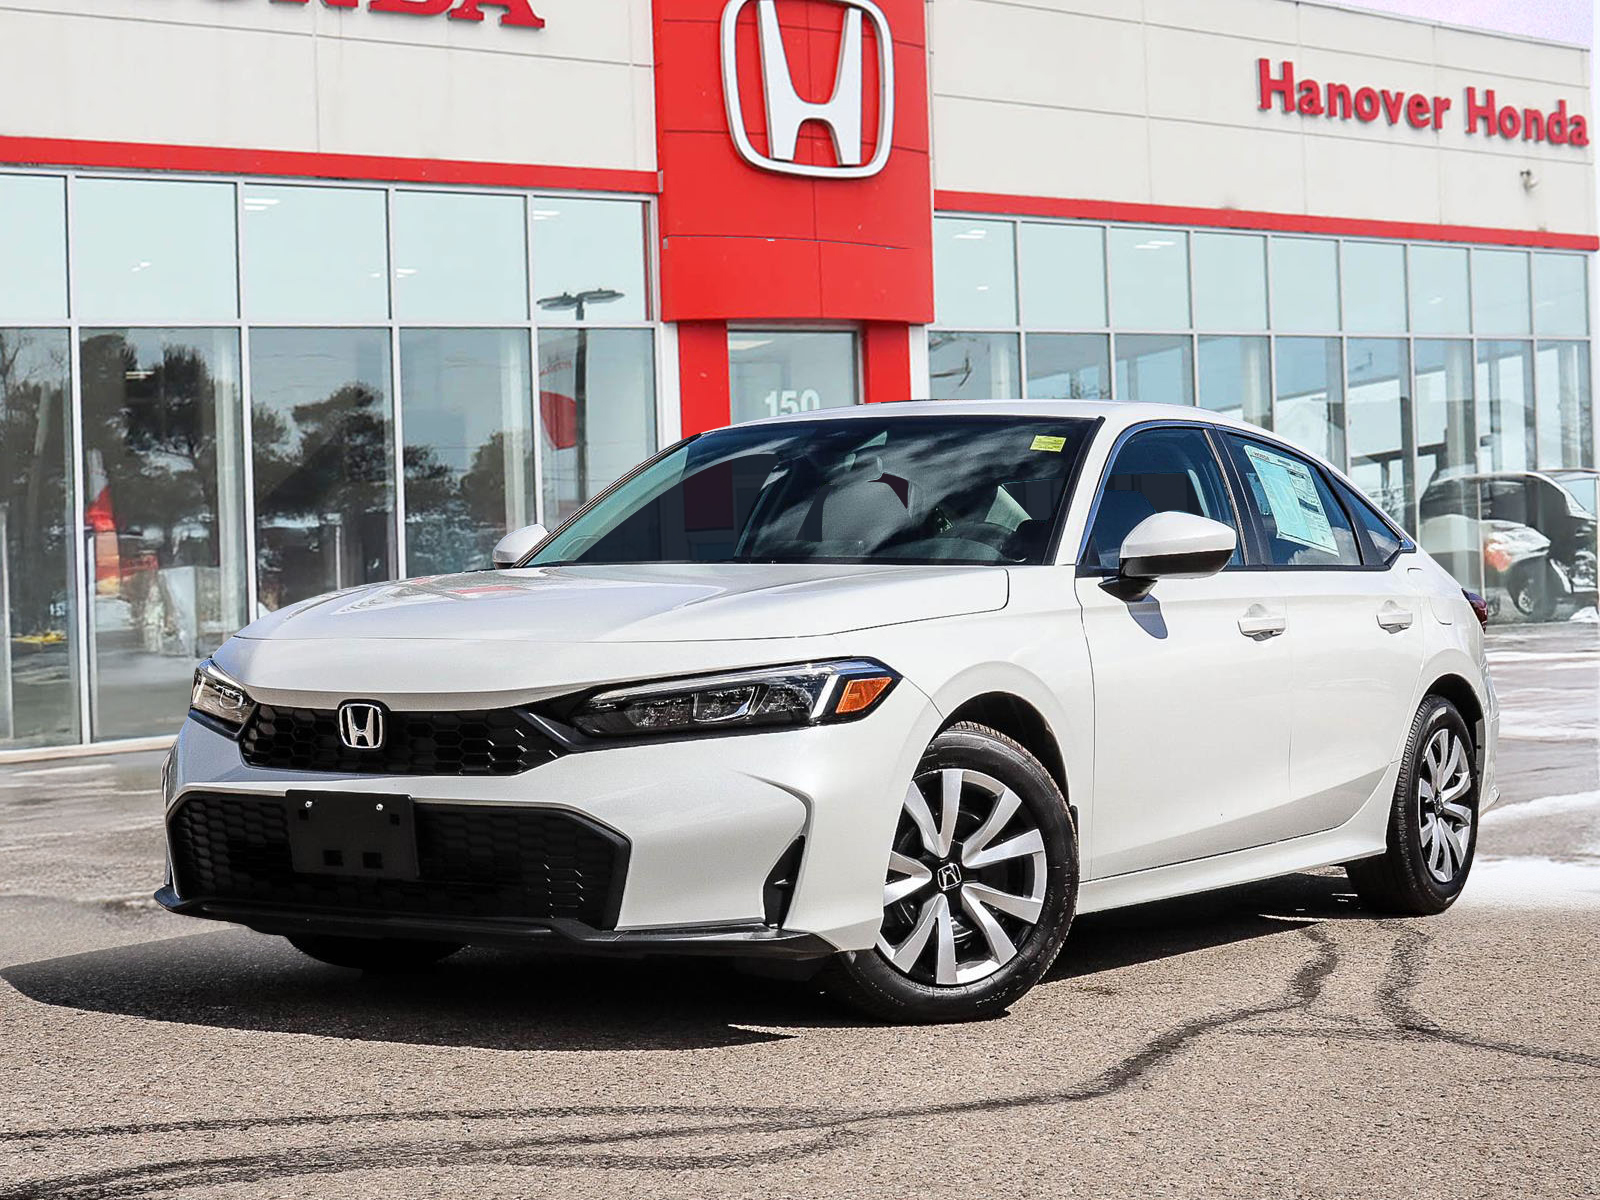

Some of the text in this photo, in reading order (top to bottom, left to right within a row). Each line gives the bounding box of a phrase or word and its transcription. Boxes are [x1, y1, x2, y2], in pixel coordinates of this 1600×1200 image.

[1258, 58, 1590, 147] Hanover Honda
[764, 388, 821, 418] 150
